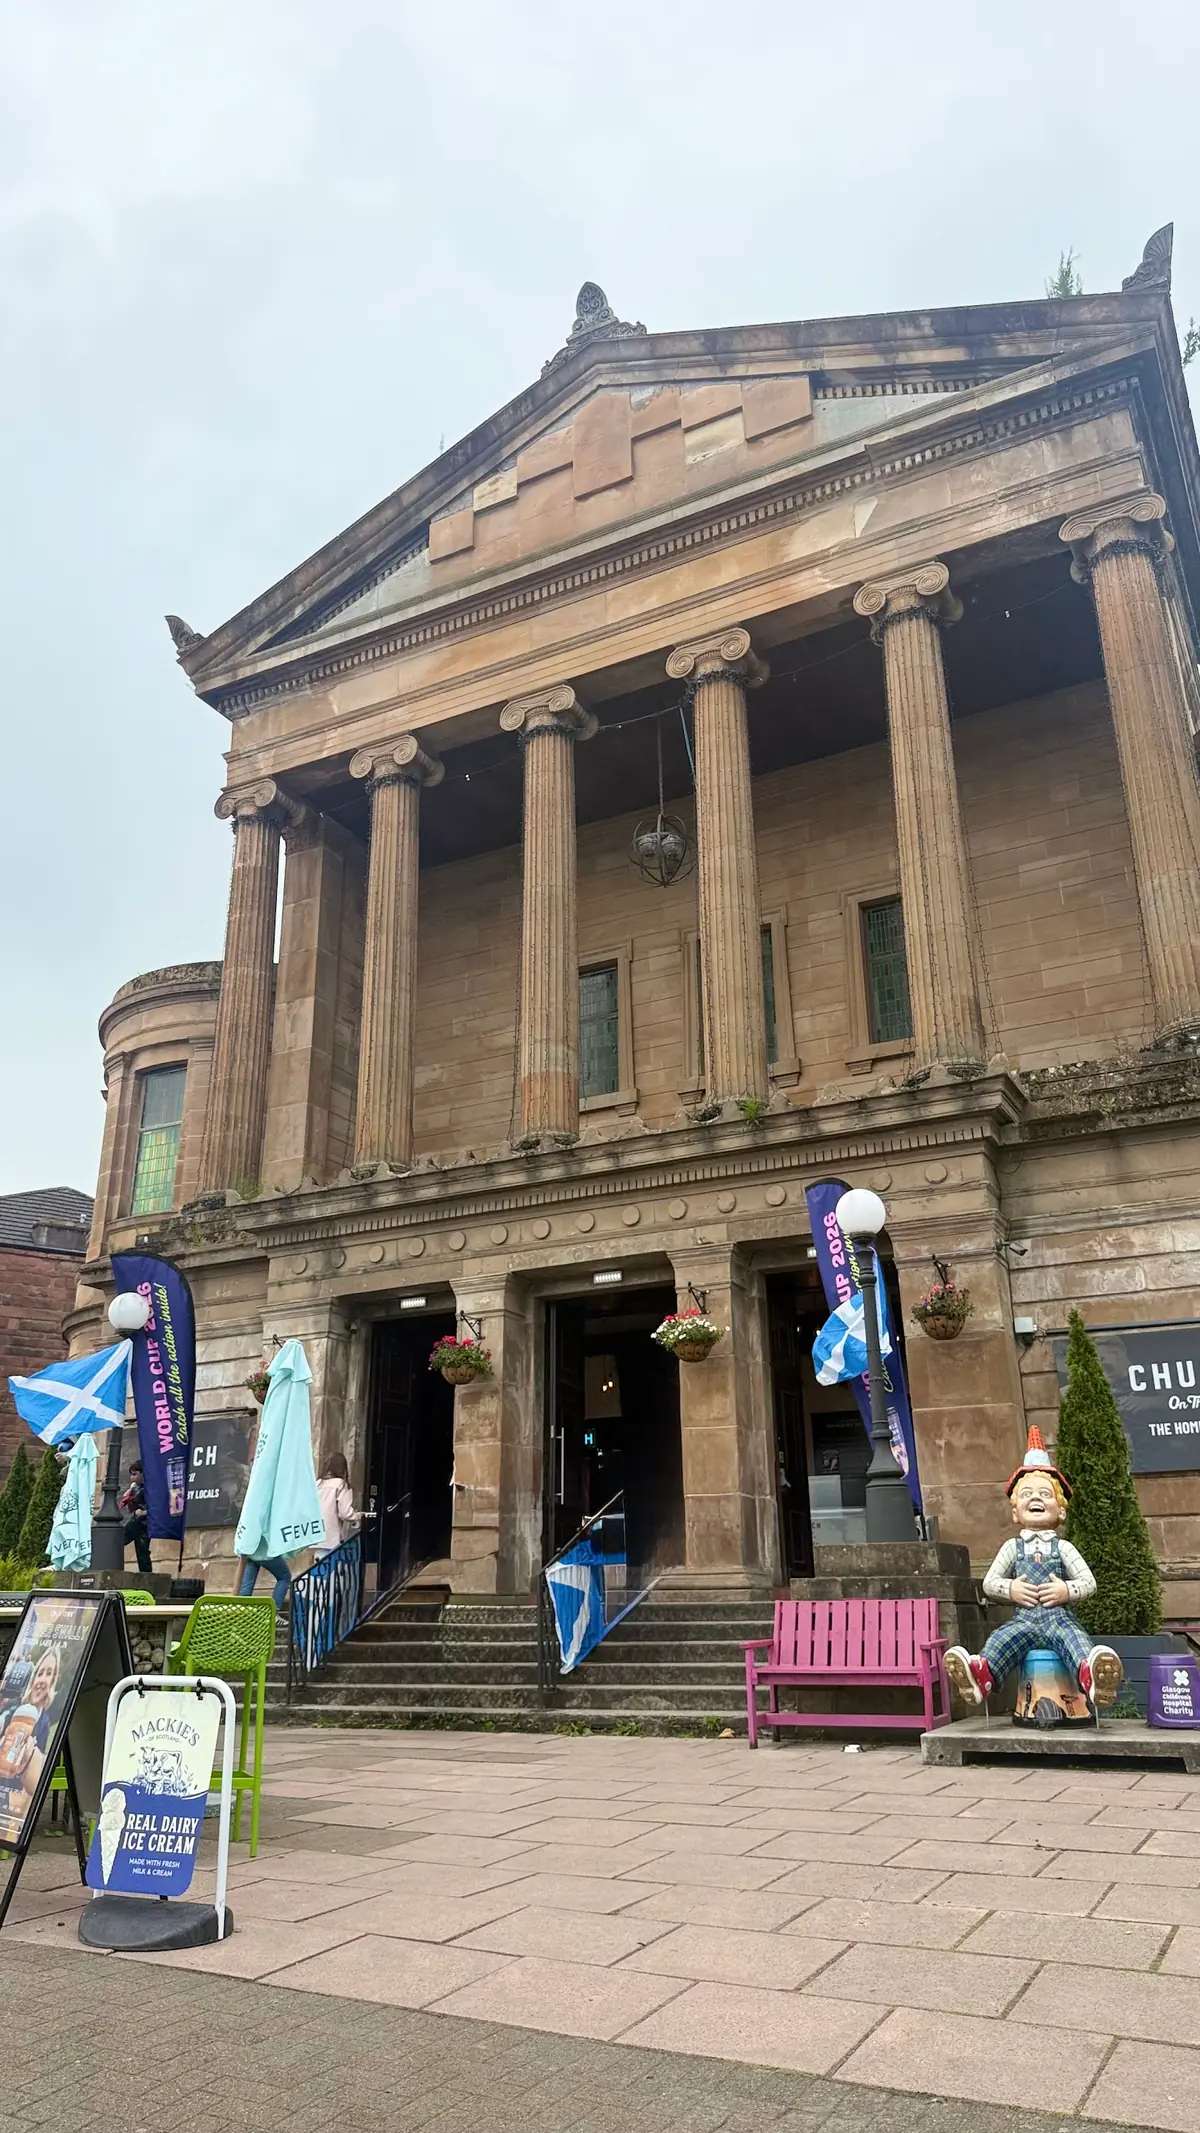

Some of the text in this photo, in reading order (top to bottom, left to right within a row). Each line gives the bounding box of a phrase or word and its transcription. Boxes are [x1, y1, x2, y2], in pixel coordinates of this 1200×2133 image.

[823, 1211, 845, 1268] 2026
[836, 1273, 851, 1303] UP
[147, 1338, 163, 1375] CUP
[153, 1282, 188, 1445] Catch all the action inside!
[1168, 1395, 1188, 1410] On
[152, 1380, 174, 1454] WORLD
[1148, 1421, 1200, 1436] THE HOM
[195, 1488, 220, 1499] LOCALS
[280, 1519, 326, 1543] FEVE
[1161, 1685, 1190, 1693] Glasgow
[1162, 1699, 1192, 1707] Hospital
[1163, 1706, 1193, 1717] Charity
[131, 1717, 200, 1747] MACKIE'S
[156, 1734, 179, 1743] SCOTLAND
[126, 1813, 200, 1835] REAL DAIRY
[122, 1831, 196, 1855] ICE CREAM
[129, 1857, 180, 1868] MADE WITH FRESH
[132, 1867, 146, 1876] MILK
[152, 1869, 173, 1877] CREAM
